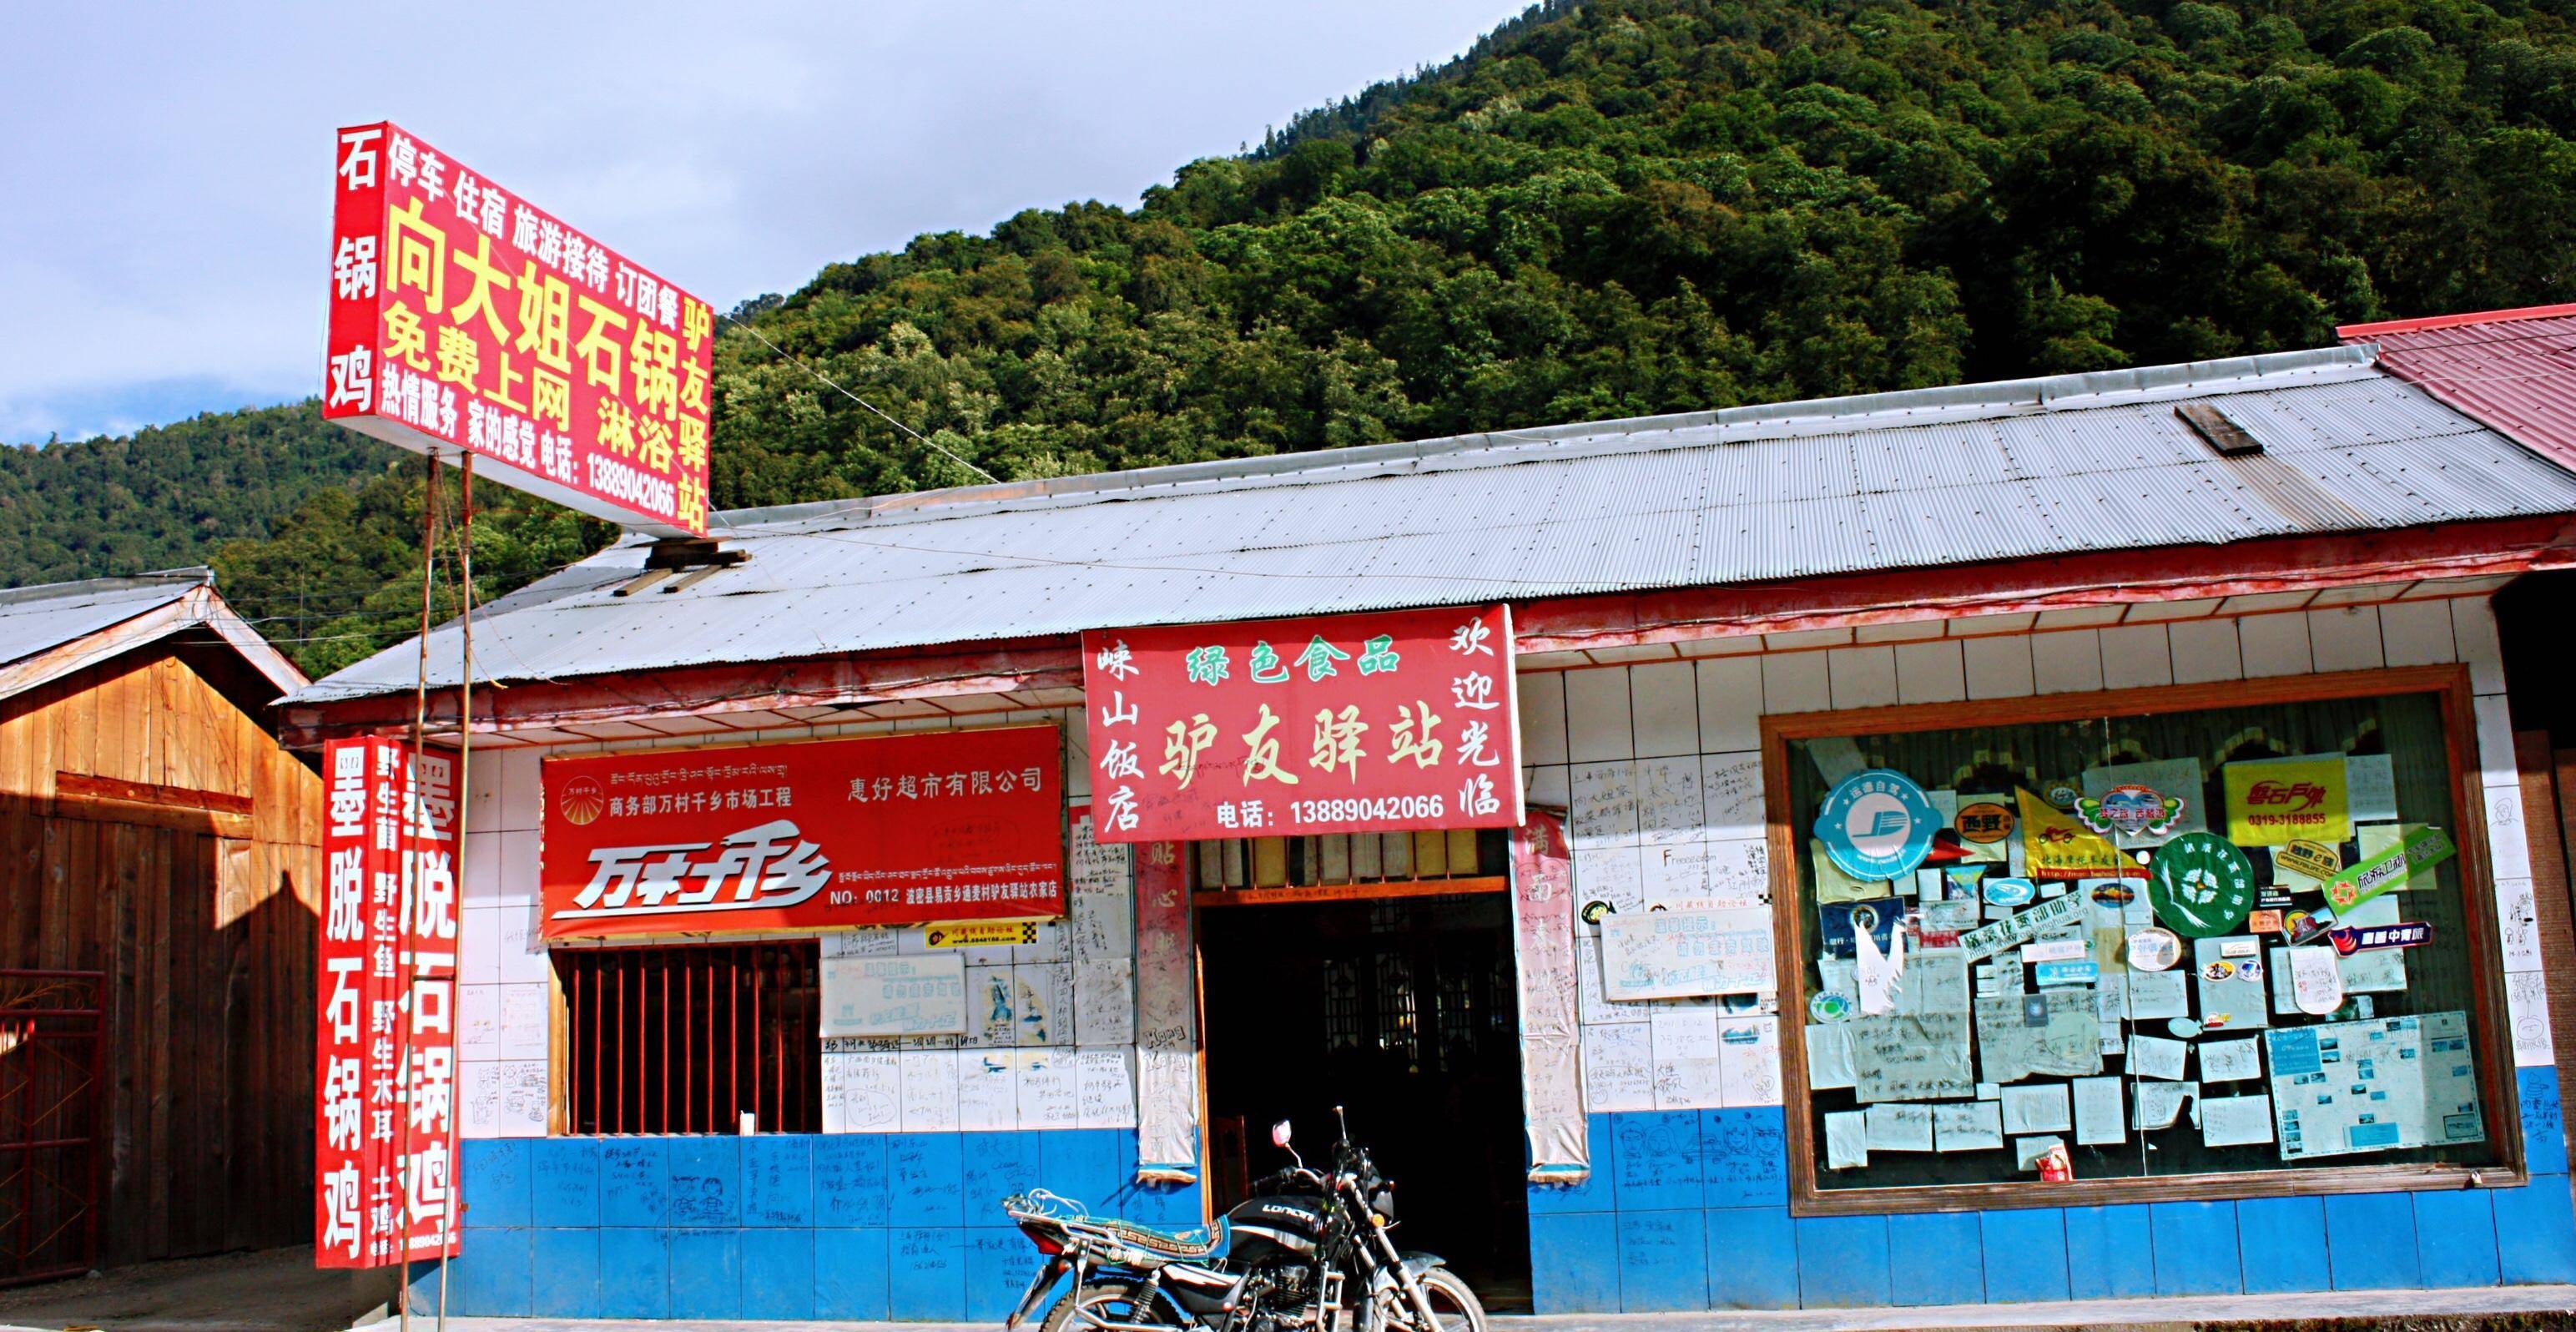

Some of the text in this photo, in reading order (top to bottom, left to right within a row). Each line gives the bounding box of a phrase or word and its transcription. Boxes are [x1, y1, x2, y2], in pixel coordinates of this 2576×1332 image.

[329, 129, 382, 412] 石锅鸡
[387, 134, 679, 331] 停车 住宿 旅游接待 订团餐
[386, 196, 678, 422] 向大姐石锅
[381, 300, 674, 474] 免费上网 淋浴
[381, 361, 459, 440] 热情服务
[466, 399, 537, 470] 家的感觉
[587, 453, 674, 517] 13889042066
[676, 295, 710, 535] 驴友驿站
[1186, 633, 1401, 687] 绿色食品
[1449, 616, 1500, 819] 欢迎光临
[609, 786, 792, 817] 商务部万村千乡市场工程
[847, 765, 1043, 805] 惠好超市有限公司
[1158, 699, 1444, 791] 驴友驿站
[1289, 794, 1444, 825] 13889042066
[561, 819, 834, 914] 万村千乡
[2248, 812, 2326, 826] 0319-3188855
[373, 872, 398, 978] 野生鱼
[396, 750, 457, 1235] 墨脱石锅鸡
[324, 746, 367, 1262] 墨脱石锅鸡
[371, 1000, 396, 1144] 野生木耳
[371, 1165, 394, 1238] 土鸡
